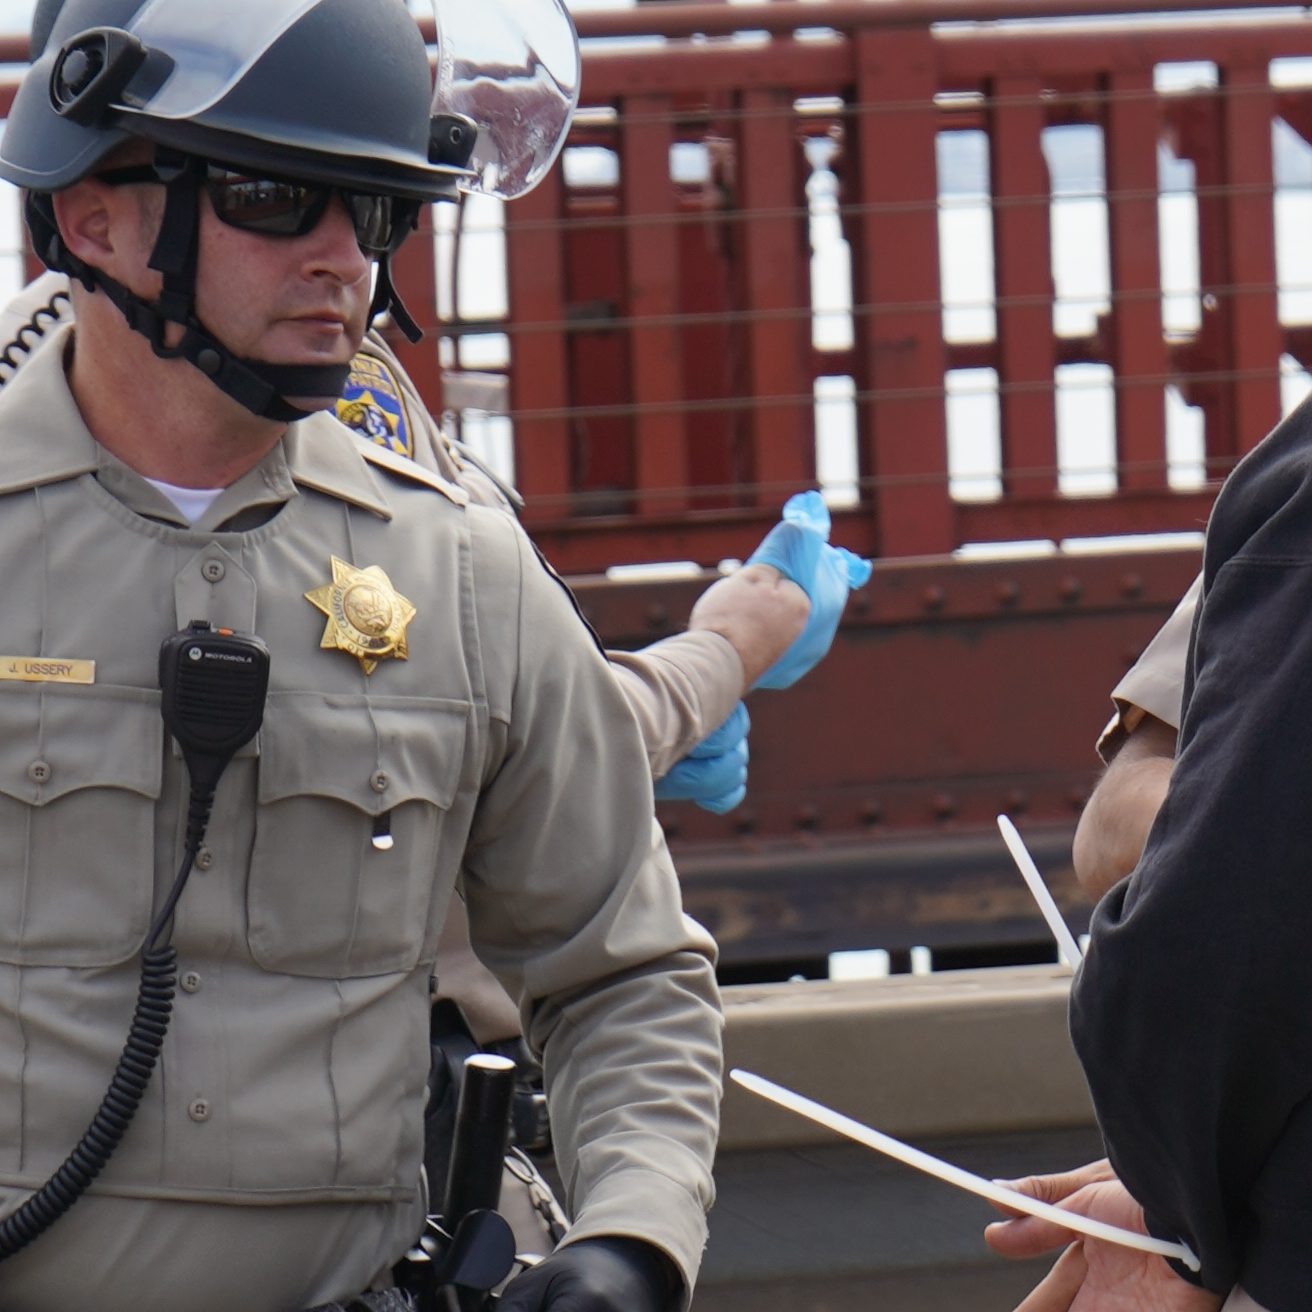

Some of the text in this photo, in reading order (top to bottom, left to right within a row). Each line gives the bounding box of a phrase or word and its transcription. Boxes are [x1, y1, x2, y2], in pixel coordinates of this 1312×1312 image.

[204, 651, 253, 664] MOTOROLA
[8, 662, 74, 678] J. USSERY
